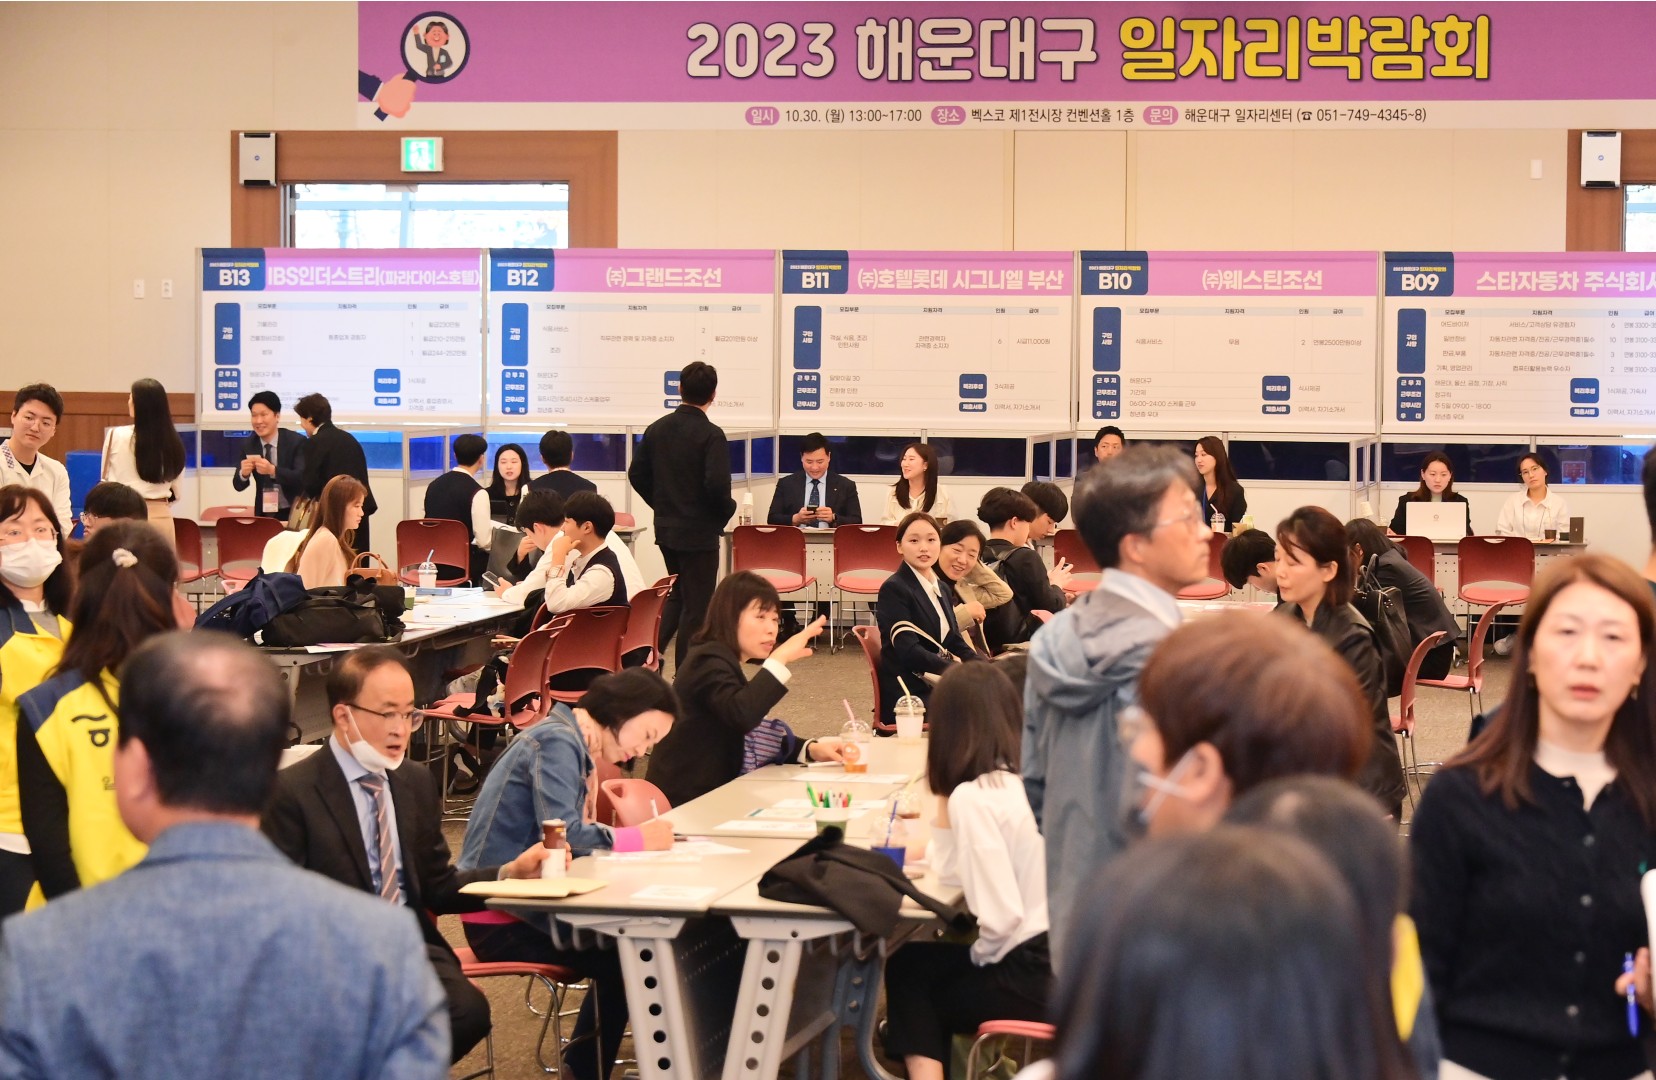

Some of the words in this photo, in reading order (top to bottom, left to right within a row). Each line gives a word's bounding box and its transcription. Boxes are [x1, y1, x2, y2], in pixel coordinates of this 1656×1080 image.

[686, 21, 837, 79] 2023
[854, 15, 1098, 82] 해운대구
[1118, 13, 1492, 82] 일자리박람회
[751, 108, 774, 124] 일시
[785, 109, 821, 123] 10.30.
[825, 108, 845, 124] (월)
[849, 108, 922, 123] 13:00~17:00
[936, 109, 961, 124] 장소
[971, 108, 1006, 123] 벡스코
[1008, 108, 1063, 123] 제1전시장
[1066, 108, 1112, 123] 컨벤션홀
[1116, 108, 1135, 123] 1층
[1149, 108, 1174, 124] 문의
[1184, 108, 1231, 123] 해운대구
[1235, 108, 1293, 123] 일자리센터
[219, 269, 250, 286] B13
[268, 266, 479, 287] IBS인더스트리(파라다이스호텔)
[507, 270, 538, 286] B12
[802, 272, 829, 288] B11
[953, 269, 1023, 290] 시그니엘
[1028, 269, 1064, 290] 부산
[1098, 273, 1132, 289] B10
[1402, 274, 1439, 291] B09
[1476, 272, 1579, 292] 스타자동차
